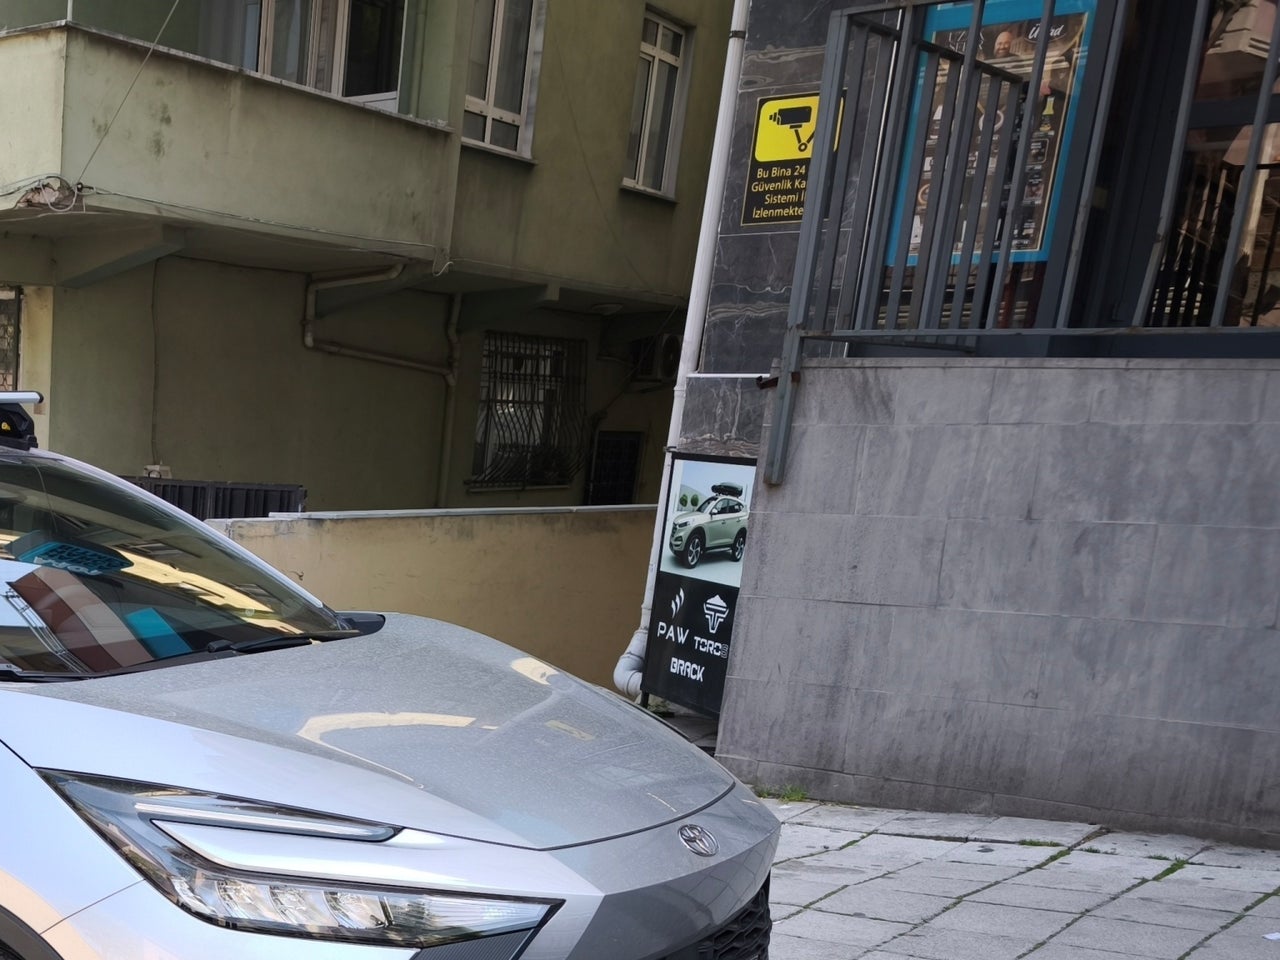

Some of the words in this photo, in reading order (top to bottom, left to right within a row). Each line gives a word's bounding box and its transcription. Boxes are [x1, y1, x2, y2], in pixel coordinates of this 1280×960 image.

[757, 168, 769, 179] Bu
[771, 167, 792, 178] Bina
[793, 165, 806, 176] 24
[751, 179, 792, 192] Güvenlik
[764, 192, 799, 205] Sistemi
[752, 206, 804, 219] Izlenmekte
[657, 621, 689, 644] PAW
[694, 636, 729, 659] TOROS
[670, 657, 705, 682] BRACK
